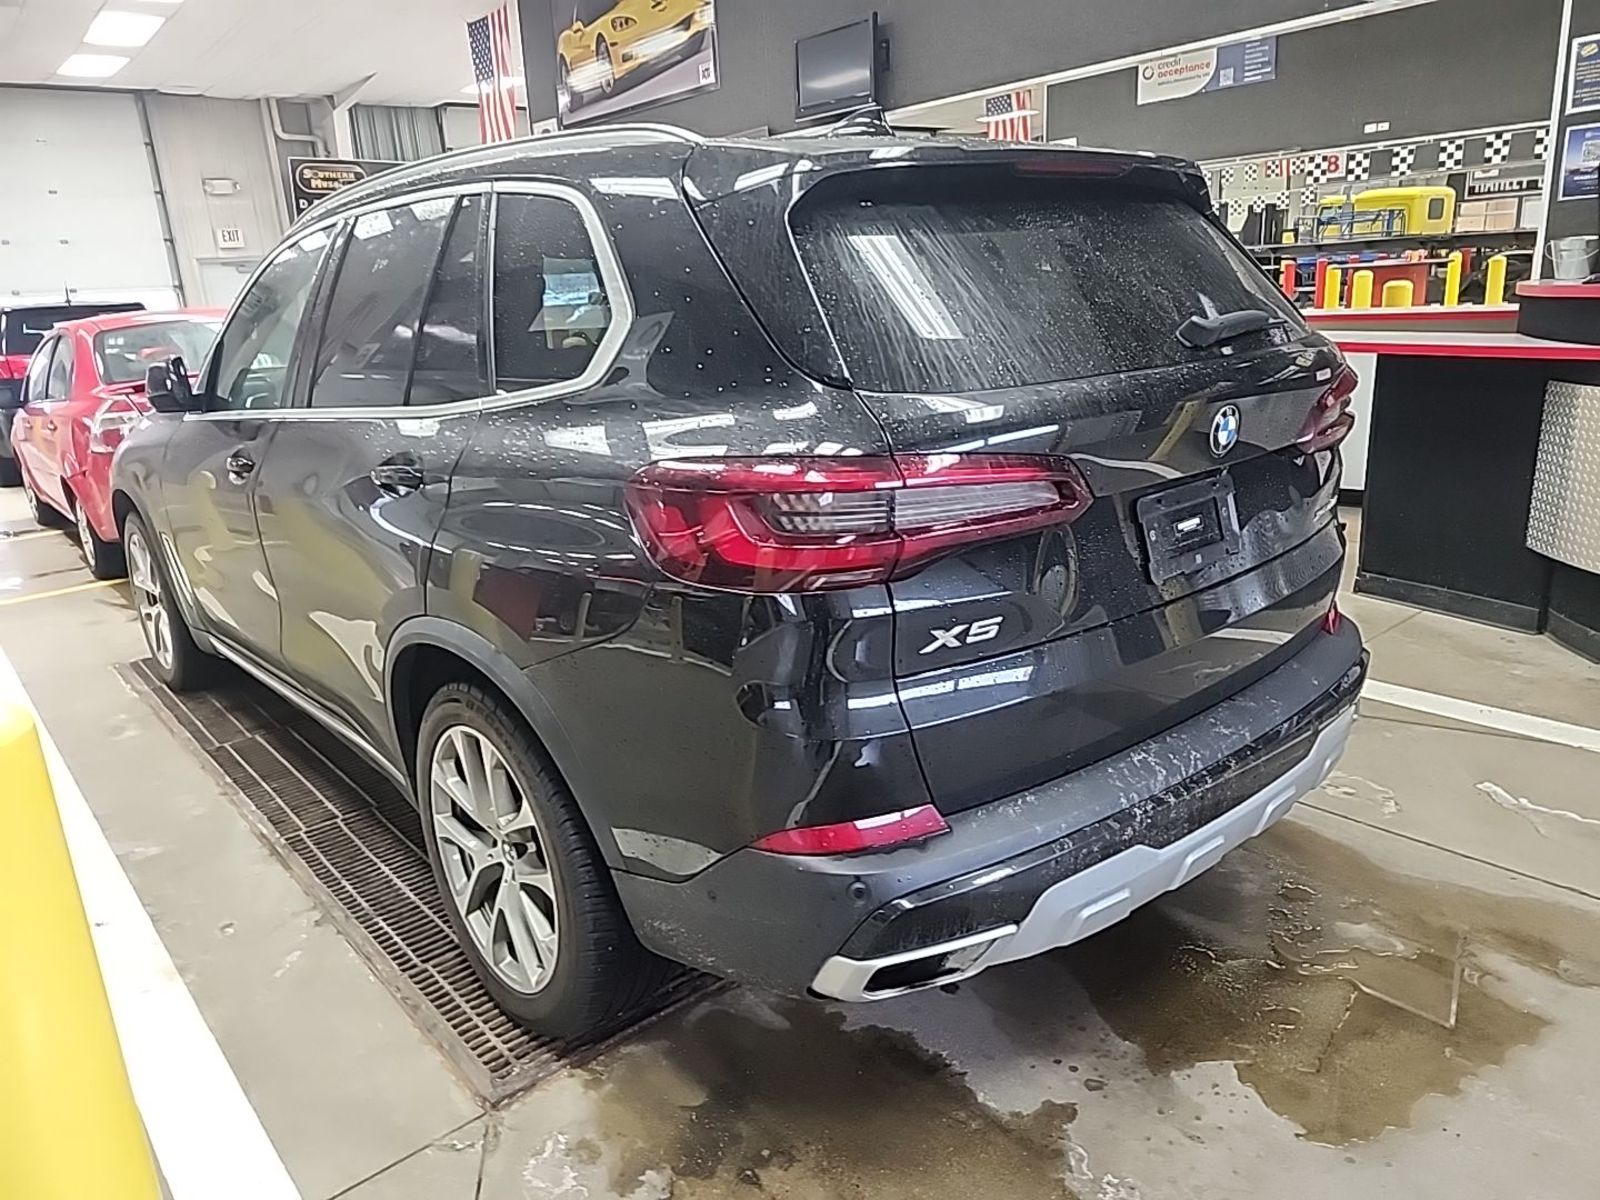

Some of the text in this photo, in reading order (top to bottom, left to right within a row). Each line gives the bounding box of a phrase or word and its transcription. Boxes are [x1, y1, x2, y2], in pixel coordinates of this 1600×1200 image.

[1157, 58, 1181, 70] credit
[1158, 62, 1211, 79] acceptance
[221, 229, 240, 243] EXIT
[918, 616, 1004, 654] X5
